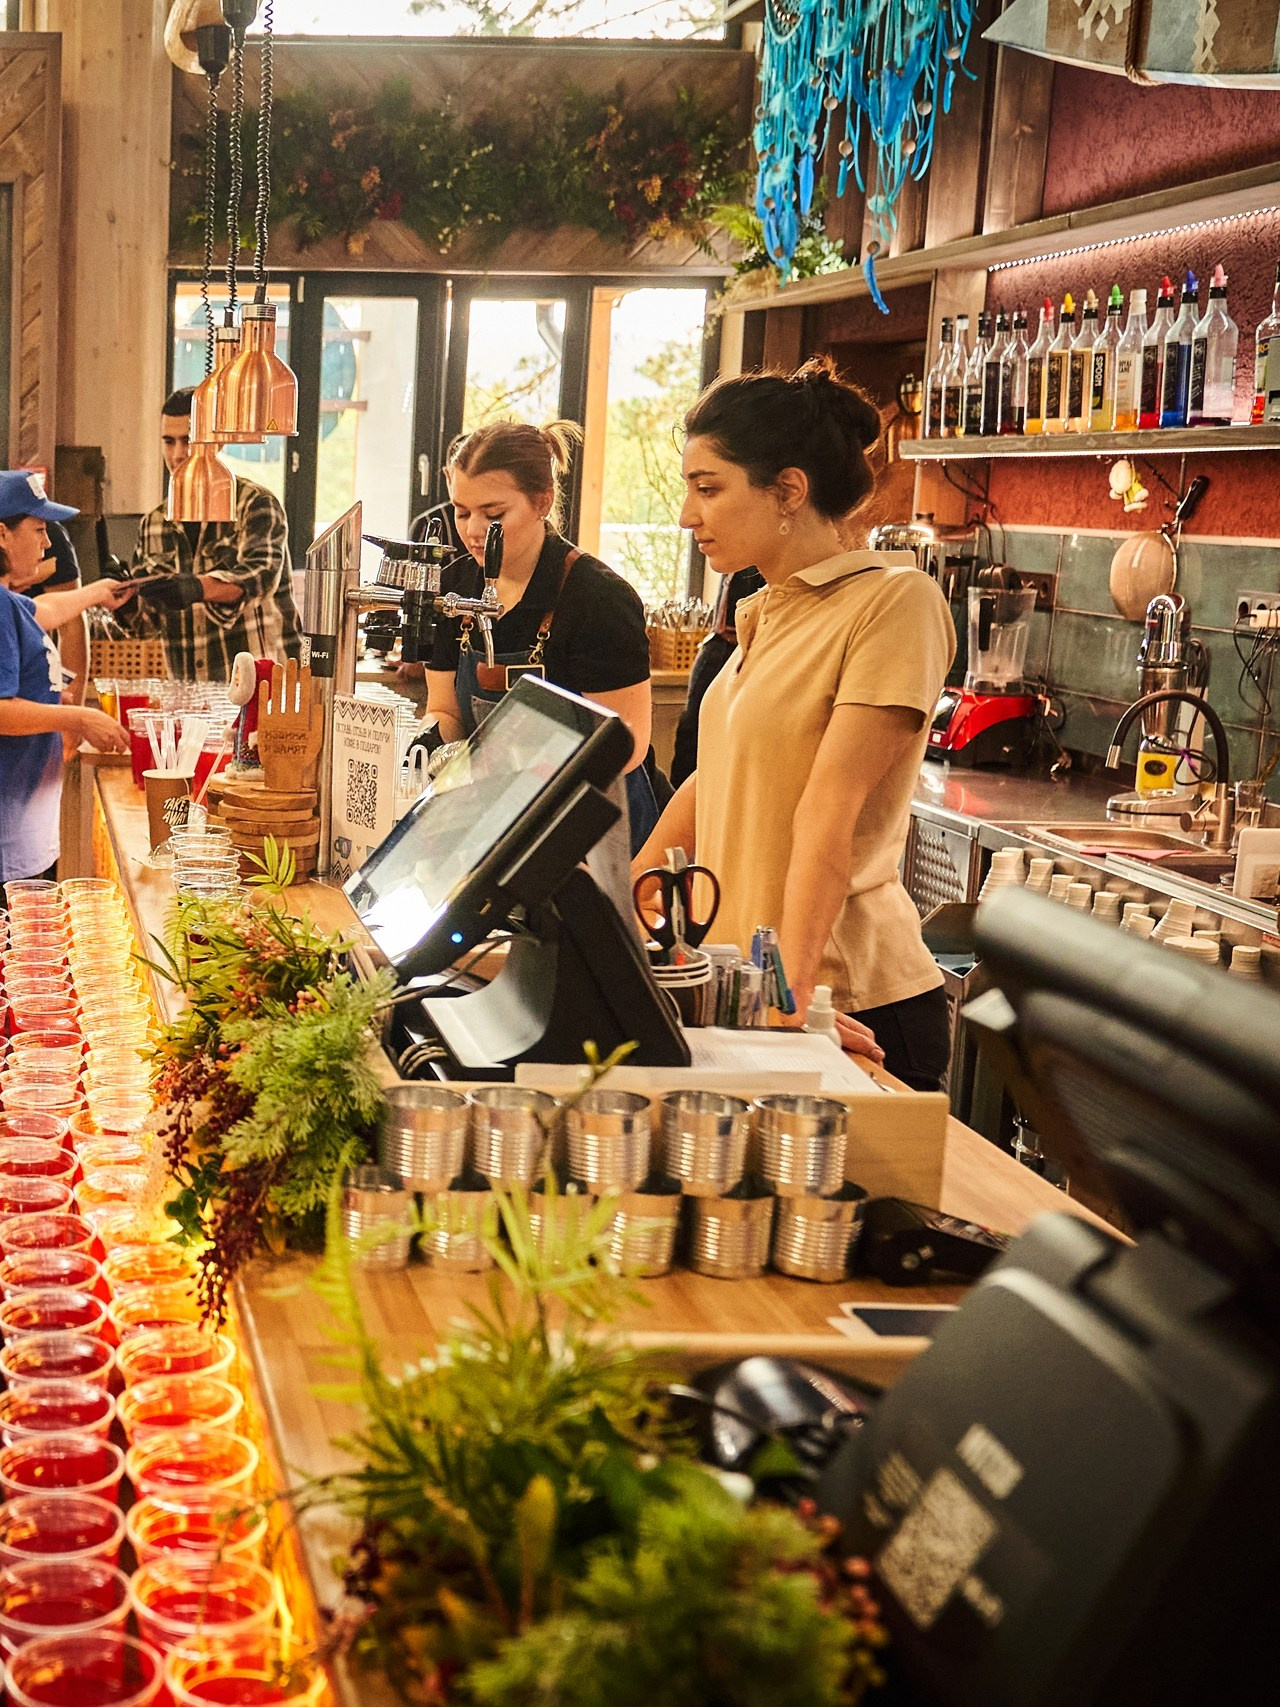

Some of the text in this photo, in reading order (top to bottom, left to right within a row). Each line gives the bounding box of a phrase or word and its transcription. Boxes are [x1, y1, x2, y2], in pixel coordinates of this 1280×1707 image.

[311, 651, 329, 659] Wi-Fi
[163, 797, 186, 811] TAKE
[162, 810, 187, 825] AWAY
